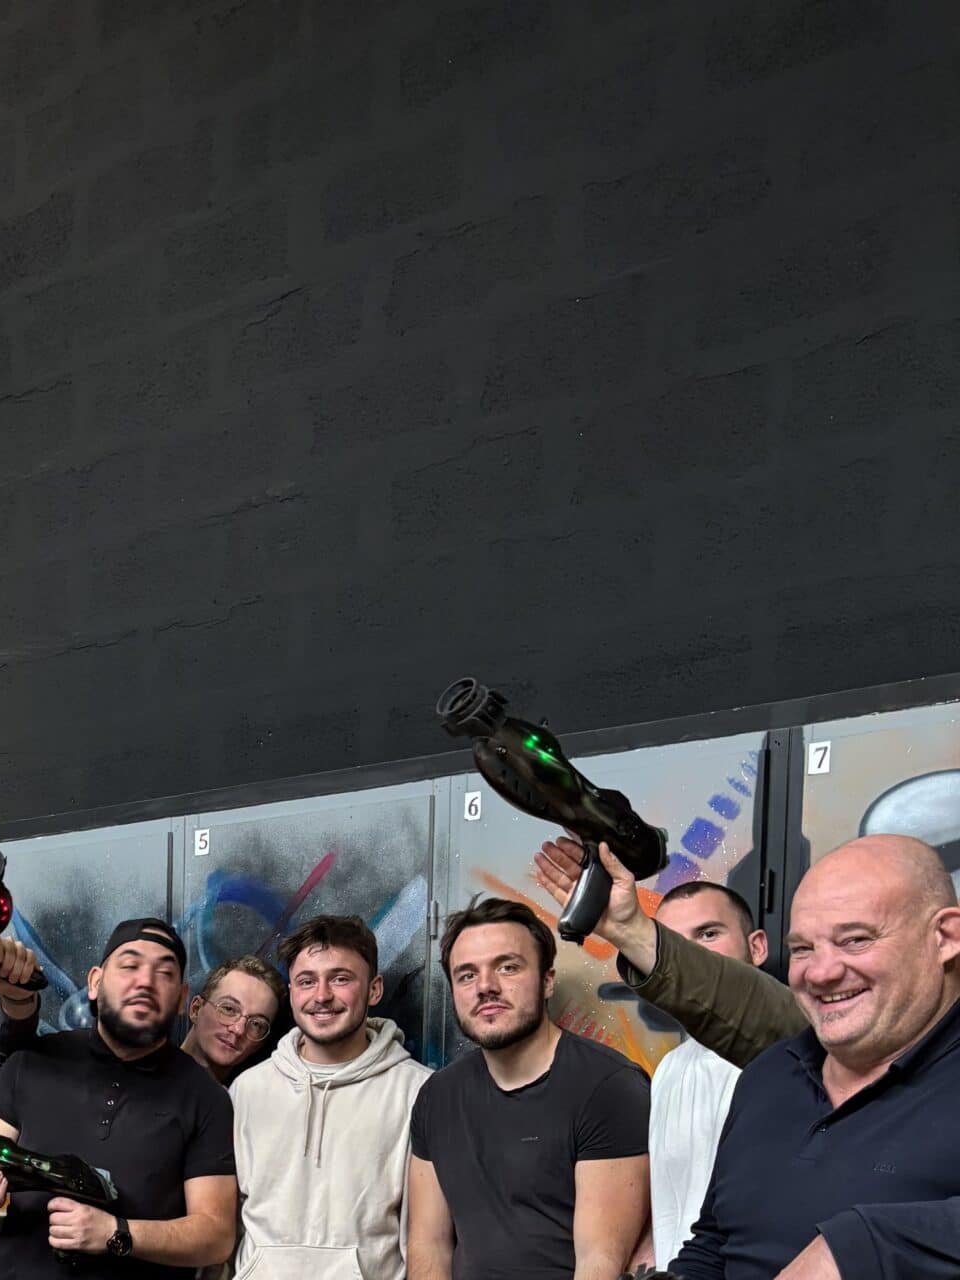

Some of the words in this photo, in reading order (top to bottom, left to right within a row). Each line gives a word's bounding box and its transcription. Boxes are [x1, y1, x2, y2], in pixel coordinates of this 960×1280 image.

[813, 746, 828, 769] 7
[468, 796, 479, 816] 6
[198, 832, 208, 850] 5
